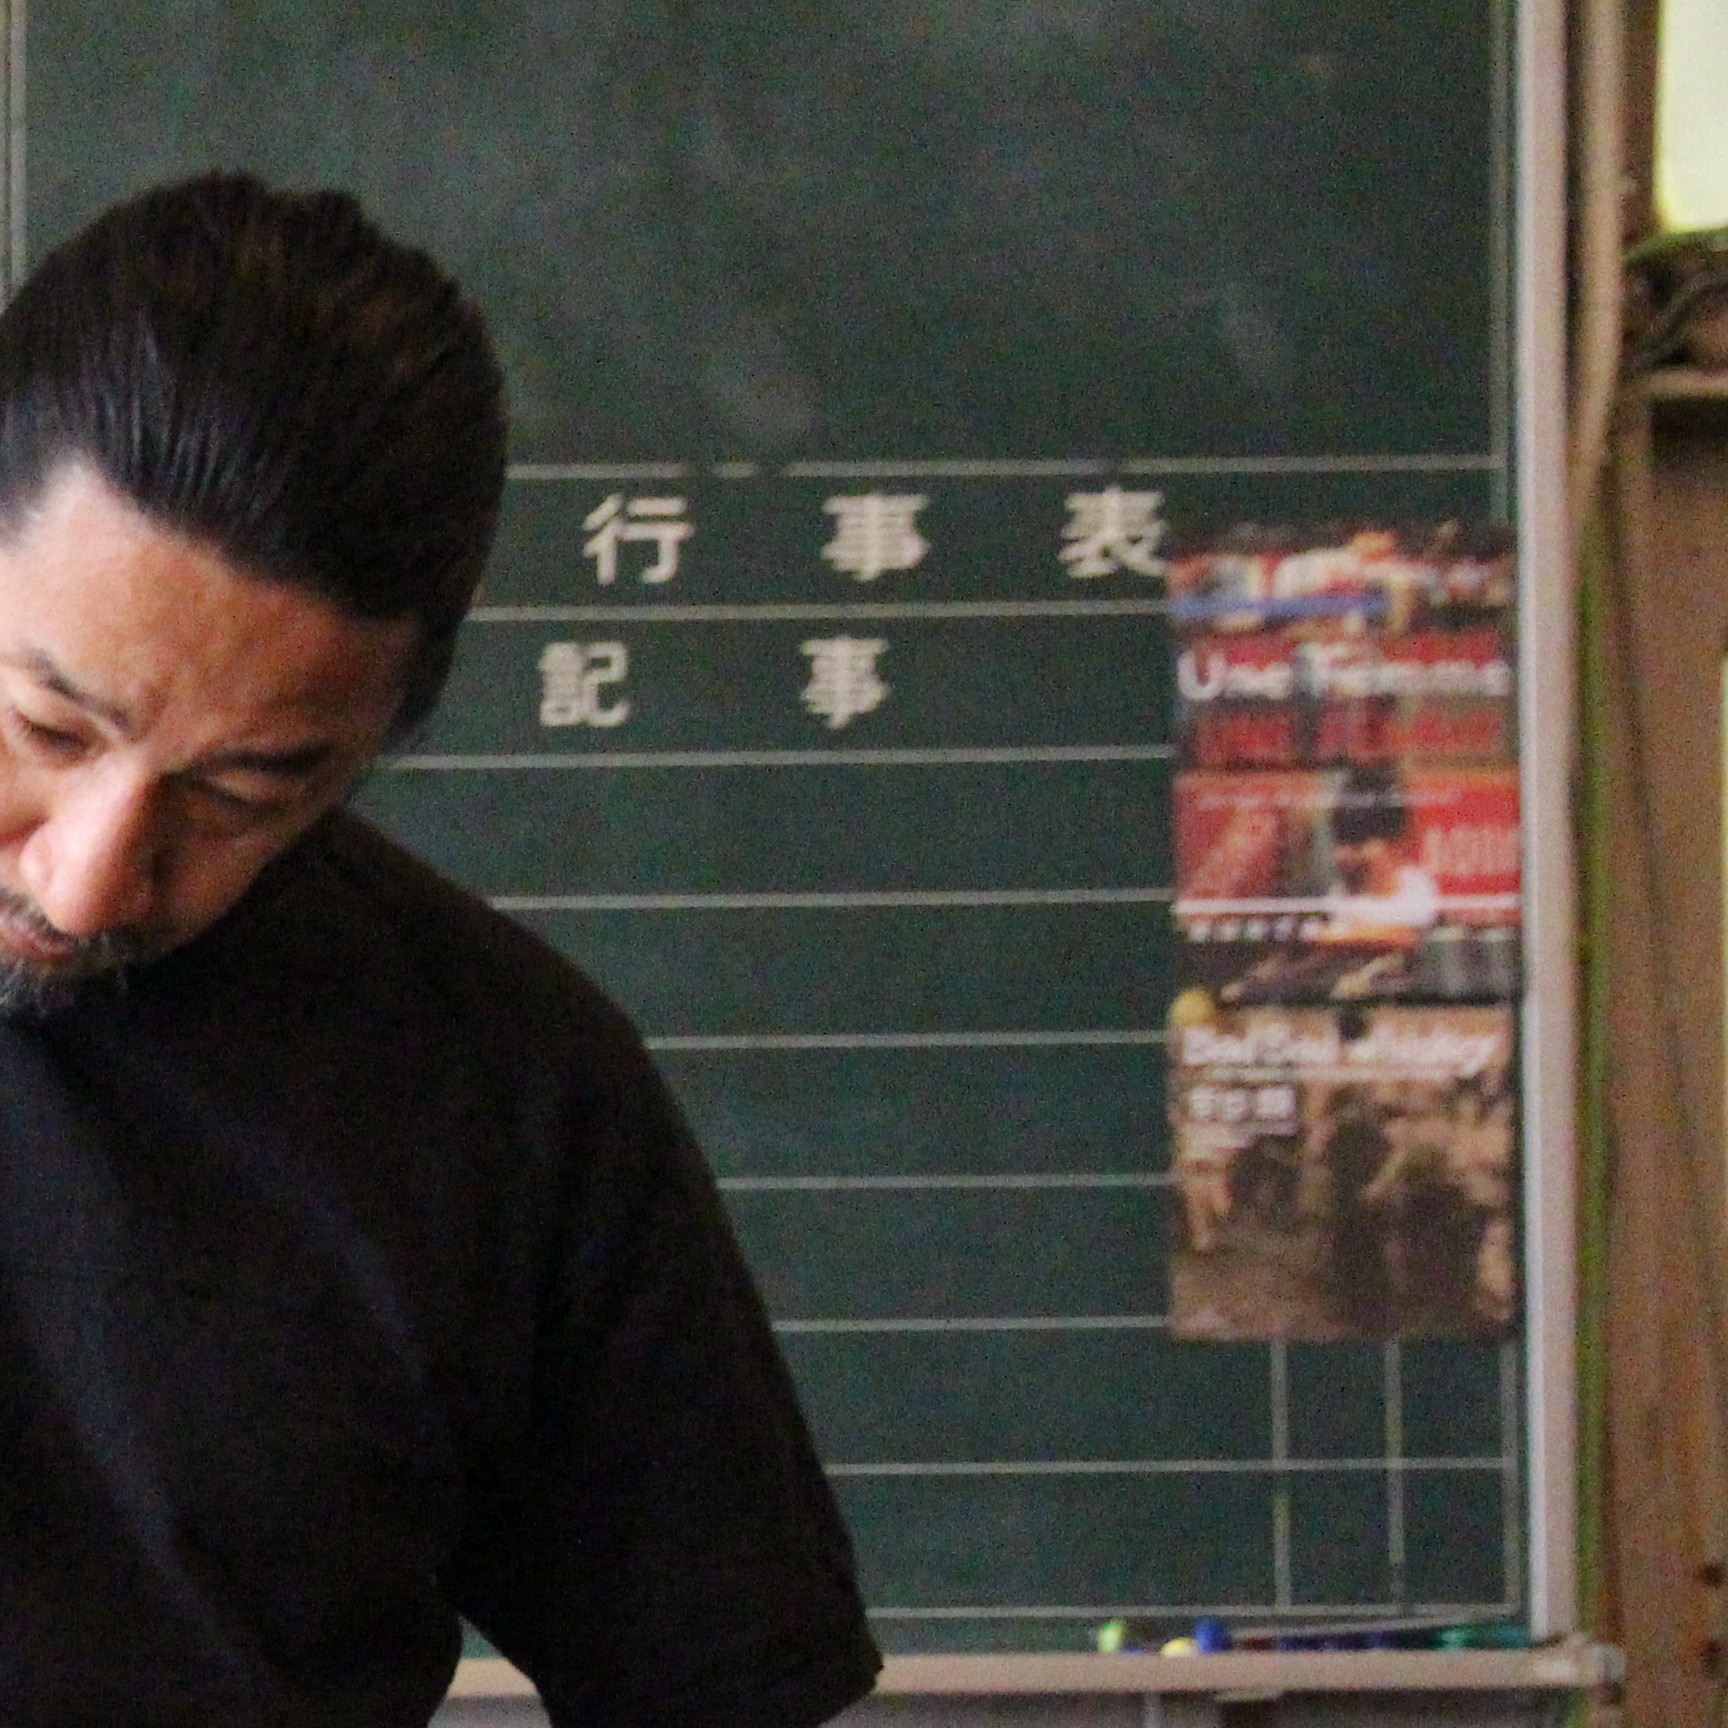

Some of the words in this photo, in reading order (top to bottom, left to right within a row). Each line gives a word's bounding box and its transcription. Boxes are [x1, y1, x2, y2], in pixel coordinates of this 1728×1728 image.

[582, 486, 1166, 585] 行事表
[538, 635, 891, 729] 記事
